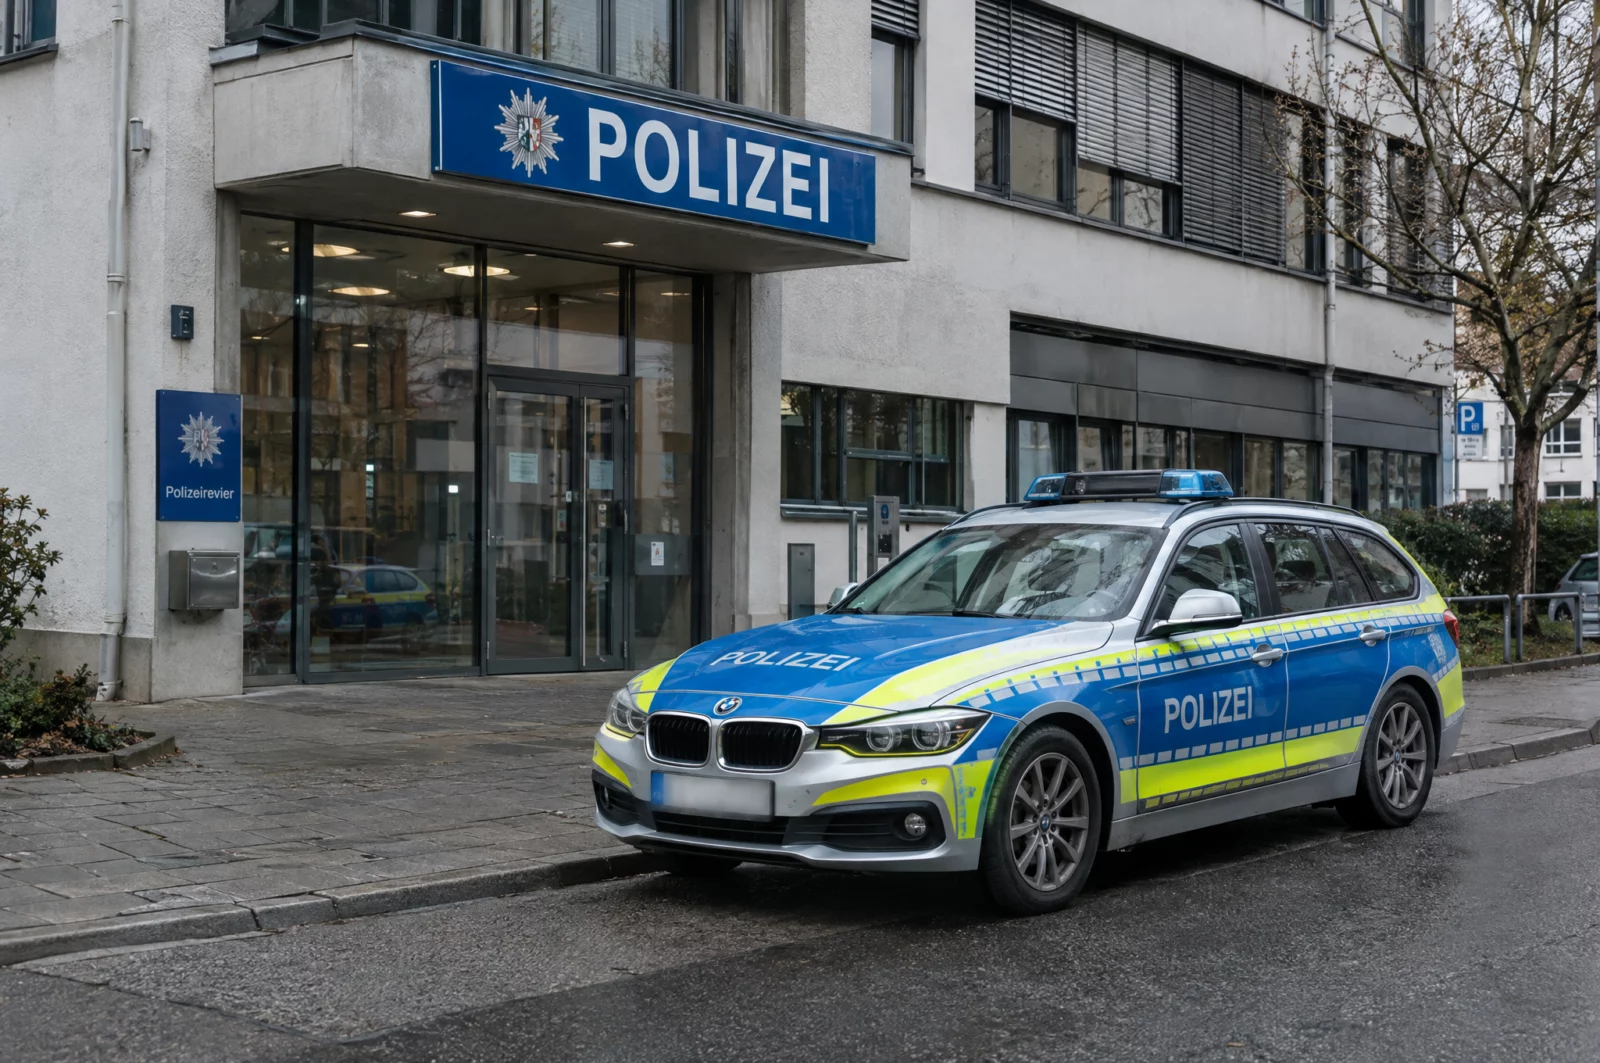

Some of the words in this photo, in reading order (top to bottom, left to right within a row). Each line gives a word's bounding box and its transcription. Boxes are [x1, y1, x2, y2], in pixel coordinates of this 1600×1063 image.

[588, 107, 829, 223] POLIZEI
[1460, 405, 1476, 432] P
[165, 485, 235, 500] Polizeirevier
[709, 651, 862, 672] POLIZEI
[1164, 685, 1253, 734] POLIZEI
